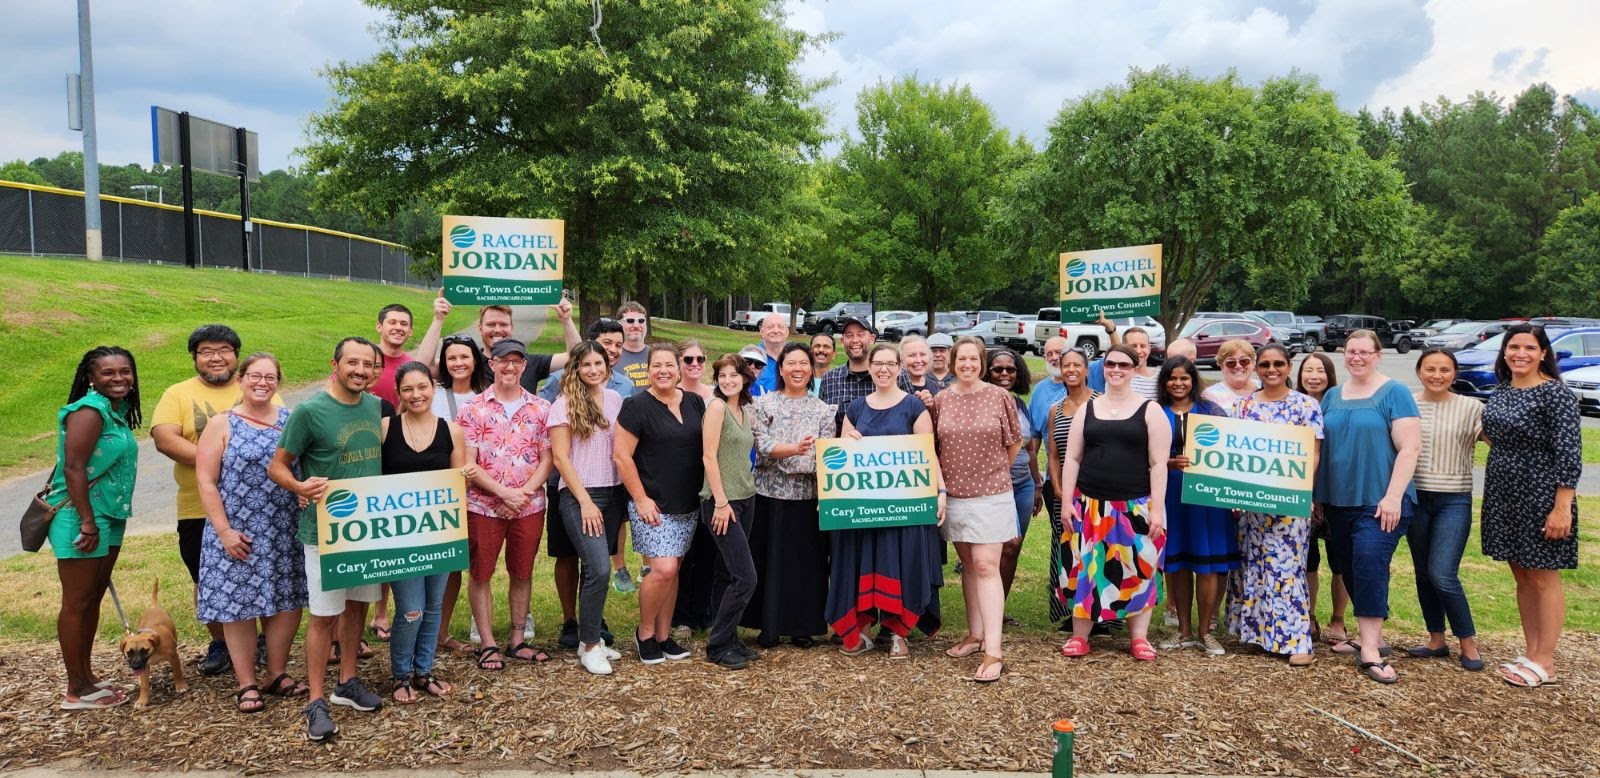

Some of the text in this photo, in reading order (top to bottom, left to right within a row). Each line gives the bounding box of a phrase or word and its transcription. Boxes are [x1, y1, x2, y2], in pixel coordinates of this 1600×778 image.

[483, 234, 557, 248] RACHEL
[449, 251, 558, 270] JORDAN
[1092, 259, 1156, 274] RACHEL
[456, 285, 480, 294] Cary
[1065, 273, 1156, 294] JORDAN
[1118, 300, 1150, 308] Council
[1226, 434, 1307, 456] RACHEL
[853, 451, 929, 467] RACHEL
[1190, 449, 1306, 479] JORDAN
[823, 469, 930, 491] JORDAN
[366, 488, 458, 512] RACHEL
[1196, 483, 1299, 503] Cary Town Council
[831, 503, 926, 517] Cary Town Council
[326, 508, 460, 545] JORDAN
[337, 548, 455, 574] Cary Town Council
[363, 564, 432, 579] RACHELFORCARY.COM
